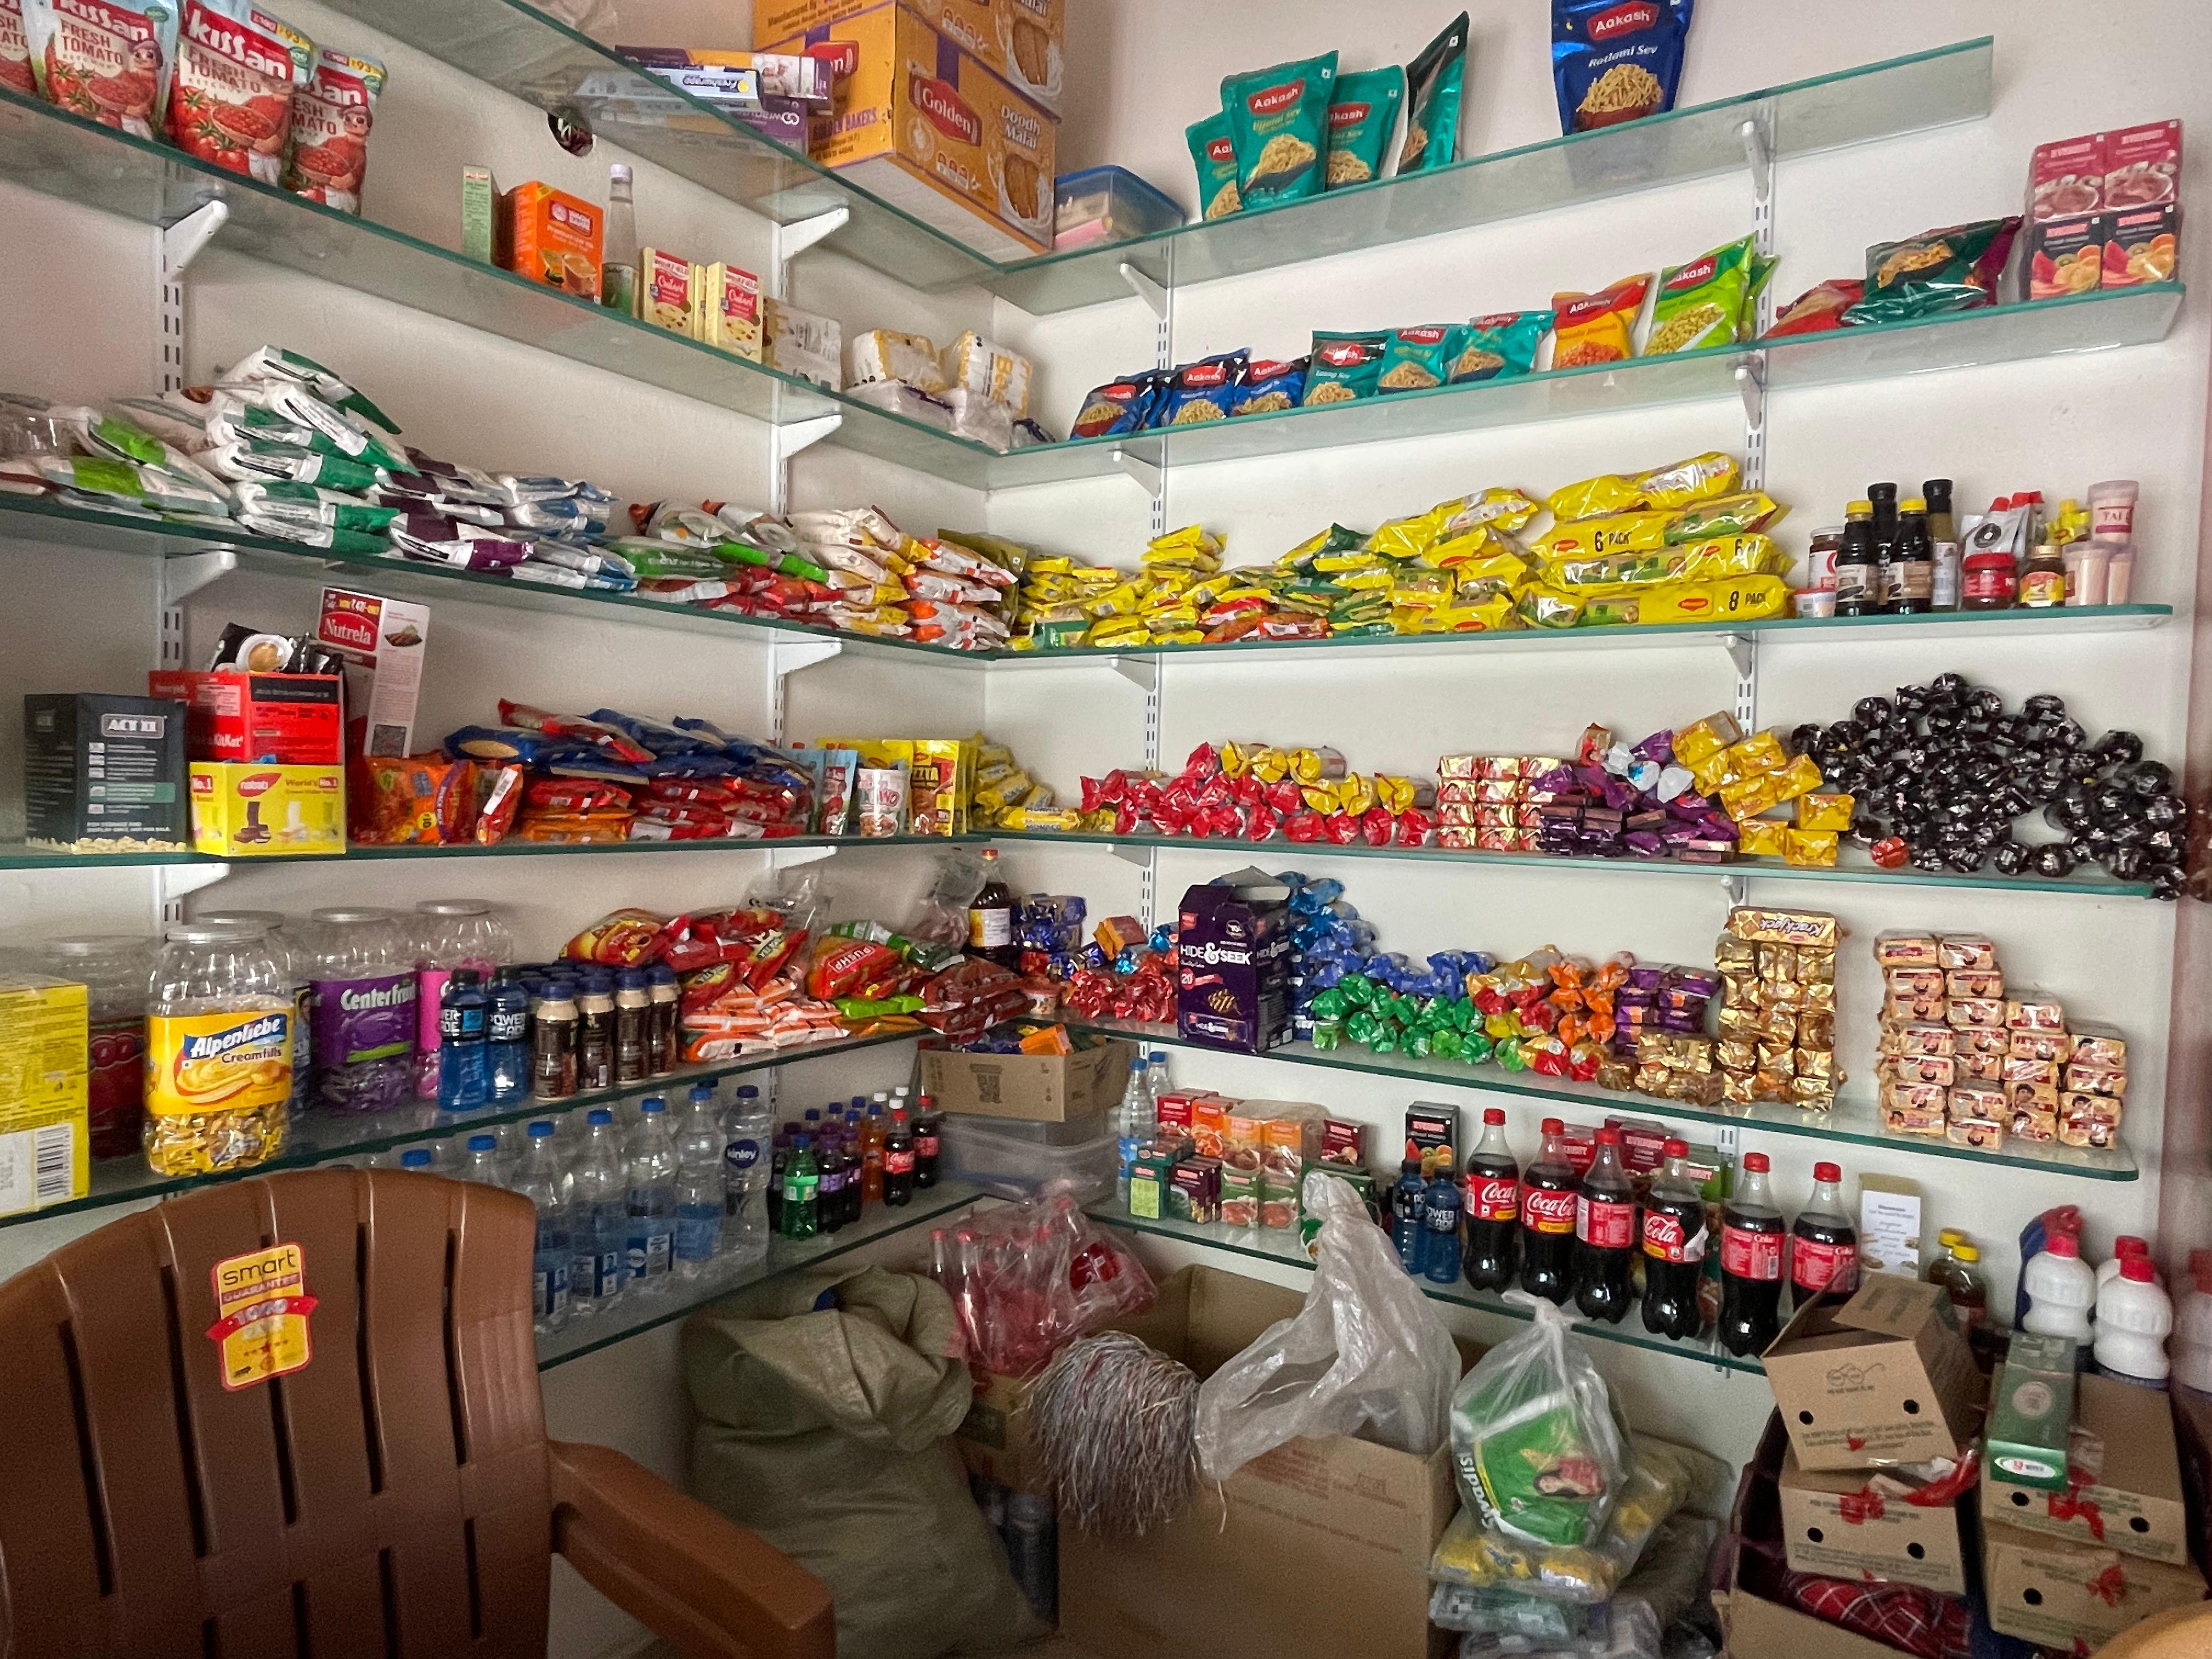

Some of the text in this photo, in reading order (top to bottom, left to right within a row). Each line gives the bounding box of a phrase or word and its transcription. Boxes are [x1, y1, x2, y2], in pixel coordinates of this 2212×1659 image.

[1595, 10, 1650, 33] Aakash
[61, 20, 110, 48] FRESH
[63, 36, 123, 65] TOMATO
[1254, 87, 1299, 110] Aakash
[922, 87, 972, 134] Golden
[1186, 372, 1220, 383] Aakash
[1594, 531, 1604, 552] 6
[1728, 590, 1739, 612] 8
[325, 617, 371, 645] Nutrela
[108, 719, 138, 732] ACT
[1181, 973, 1193, 981] 20
[190, 1018, 281, 1059] Alpenliebe
[222, 1047, 282, 1063] Creamfills
[222, 1249, 297, 1286] smart
